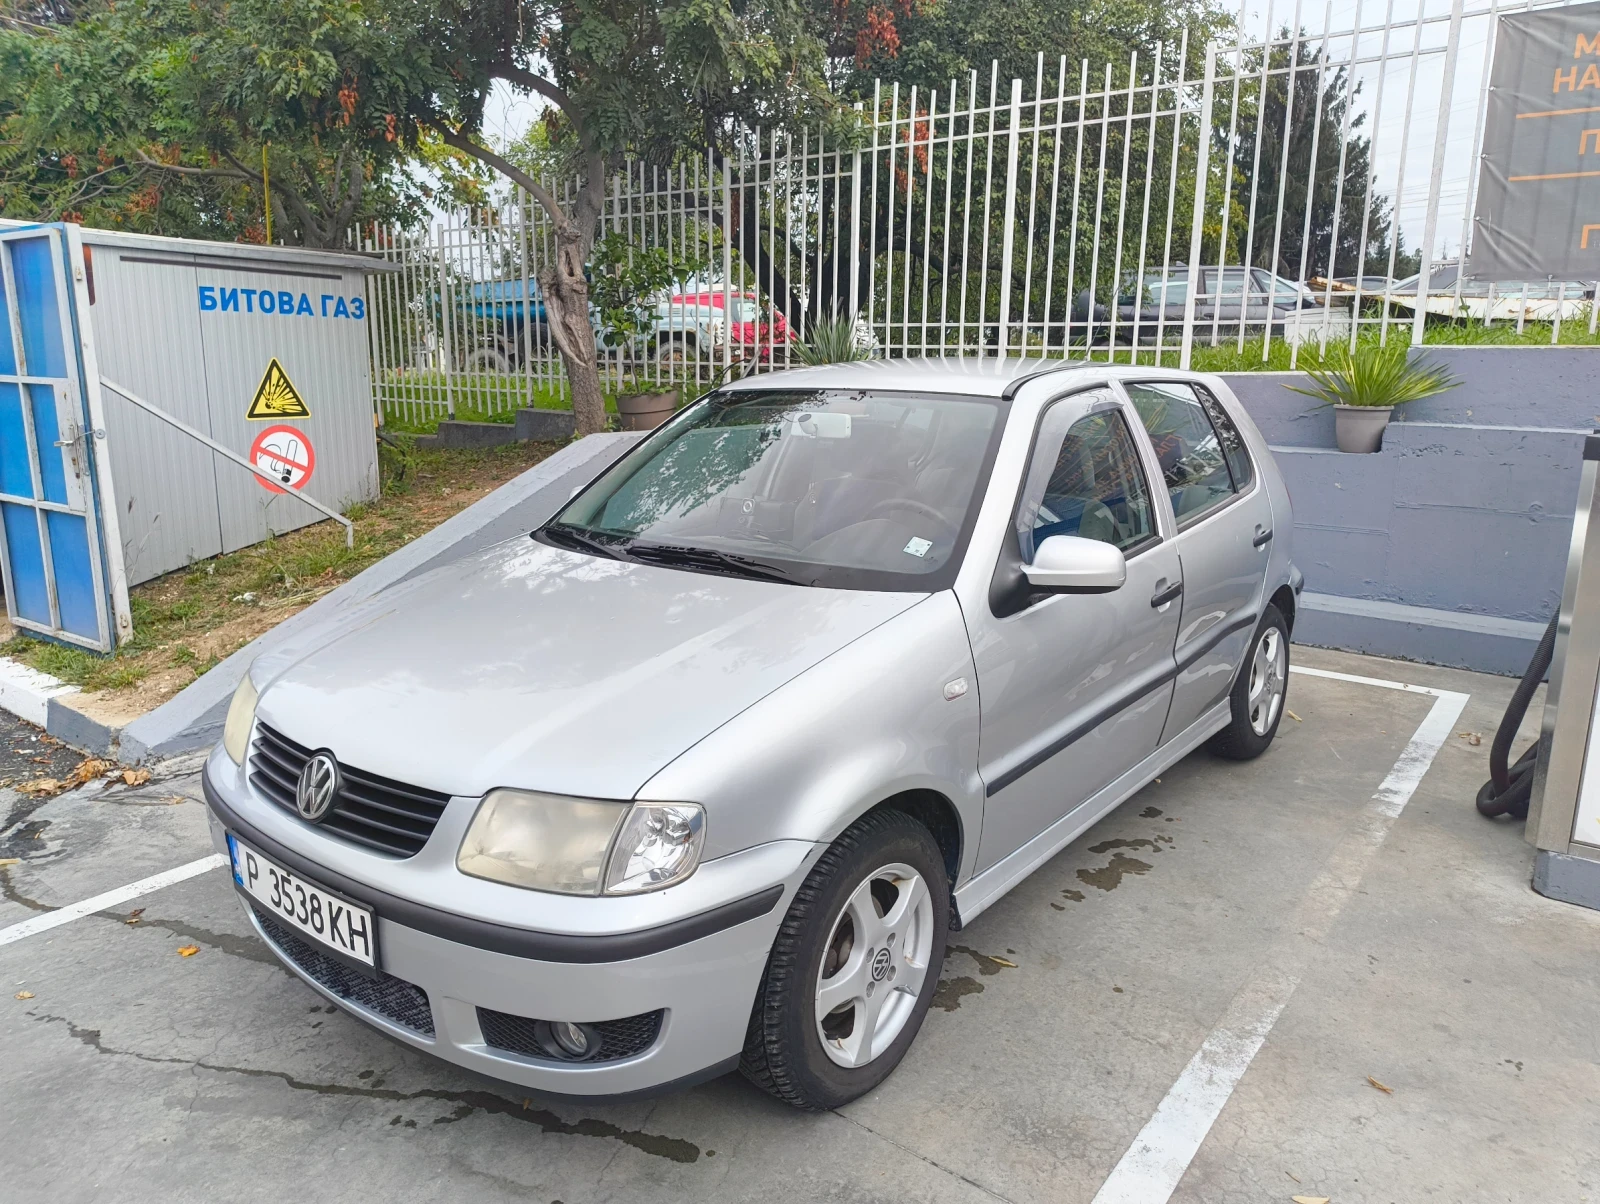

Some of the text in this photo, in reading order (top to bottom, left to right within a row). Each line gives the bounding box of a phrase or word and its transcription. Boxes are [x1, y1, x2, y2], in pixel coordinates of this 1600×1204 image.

[199, 286, 365, 320] БИТОВА ГАЗ
[245, 851, 259, 889] P
